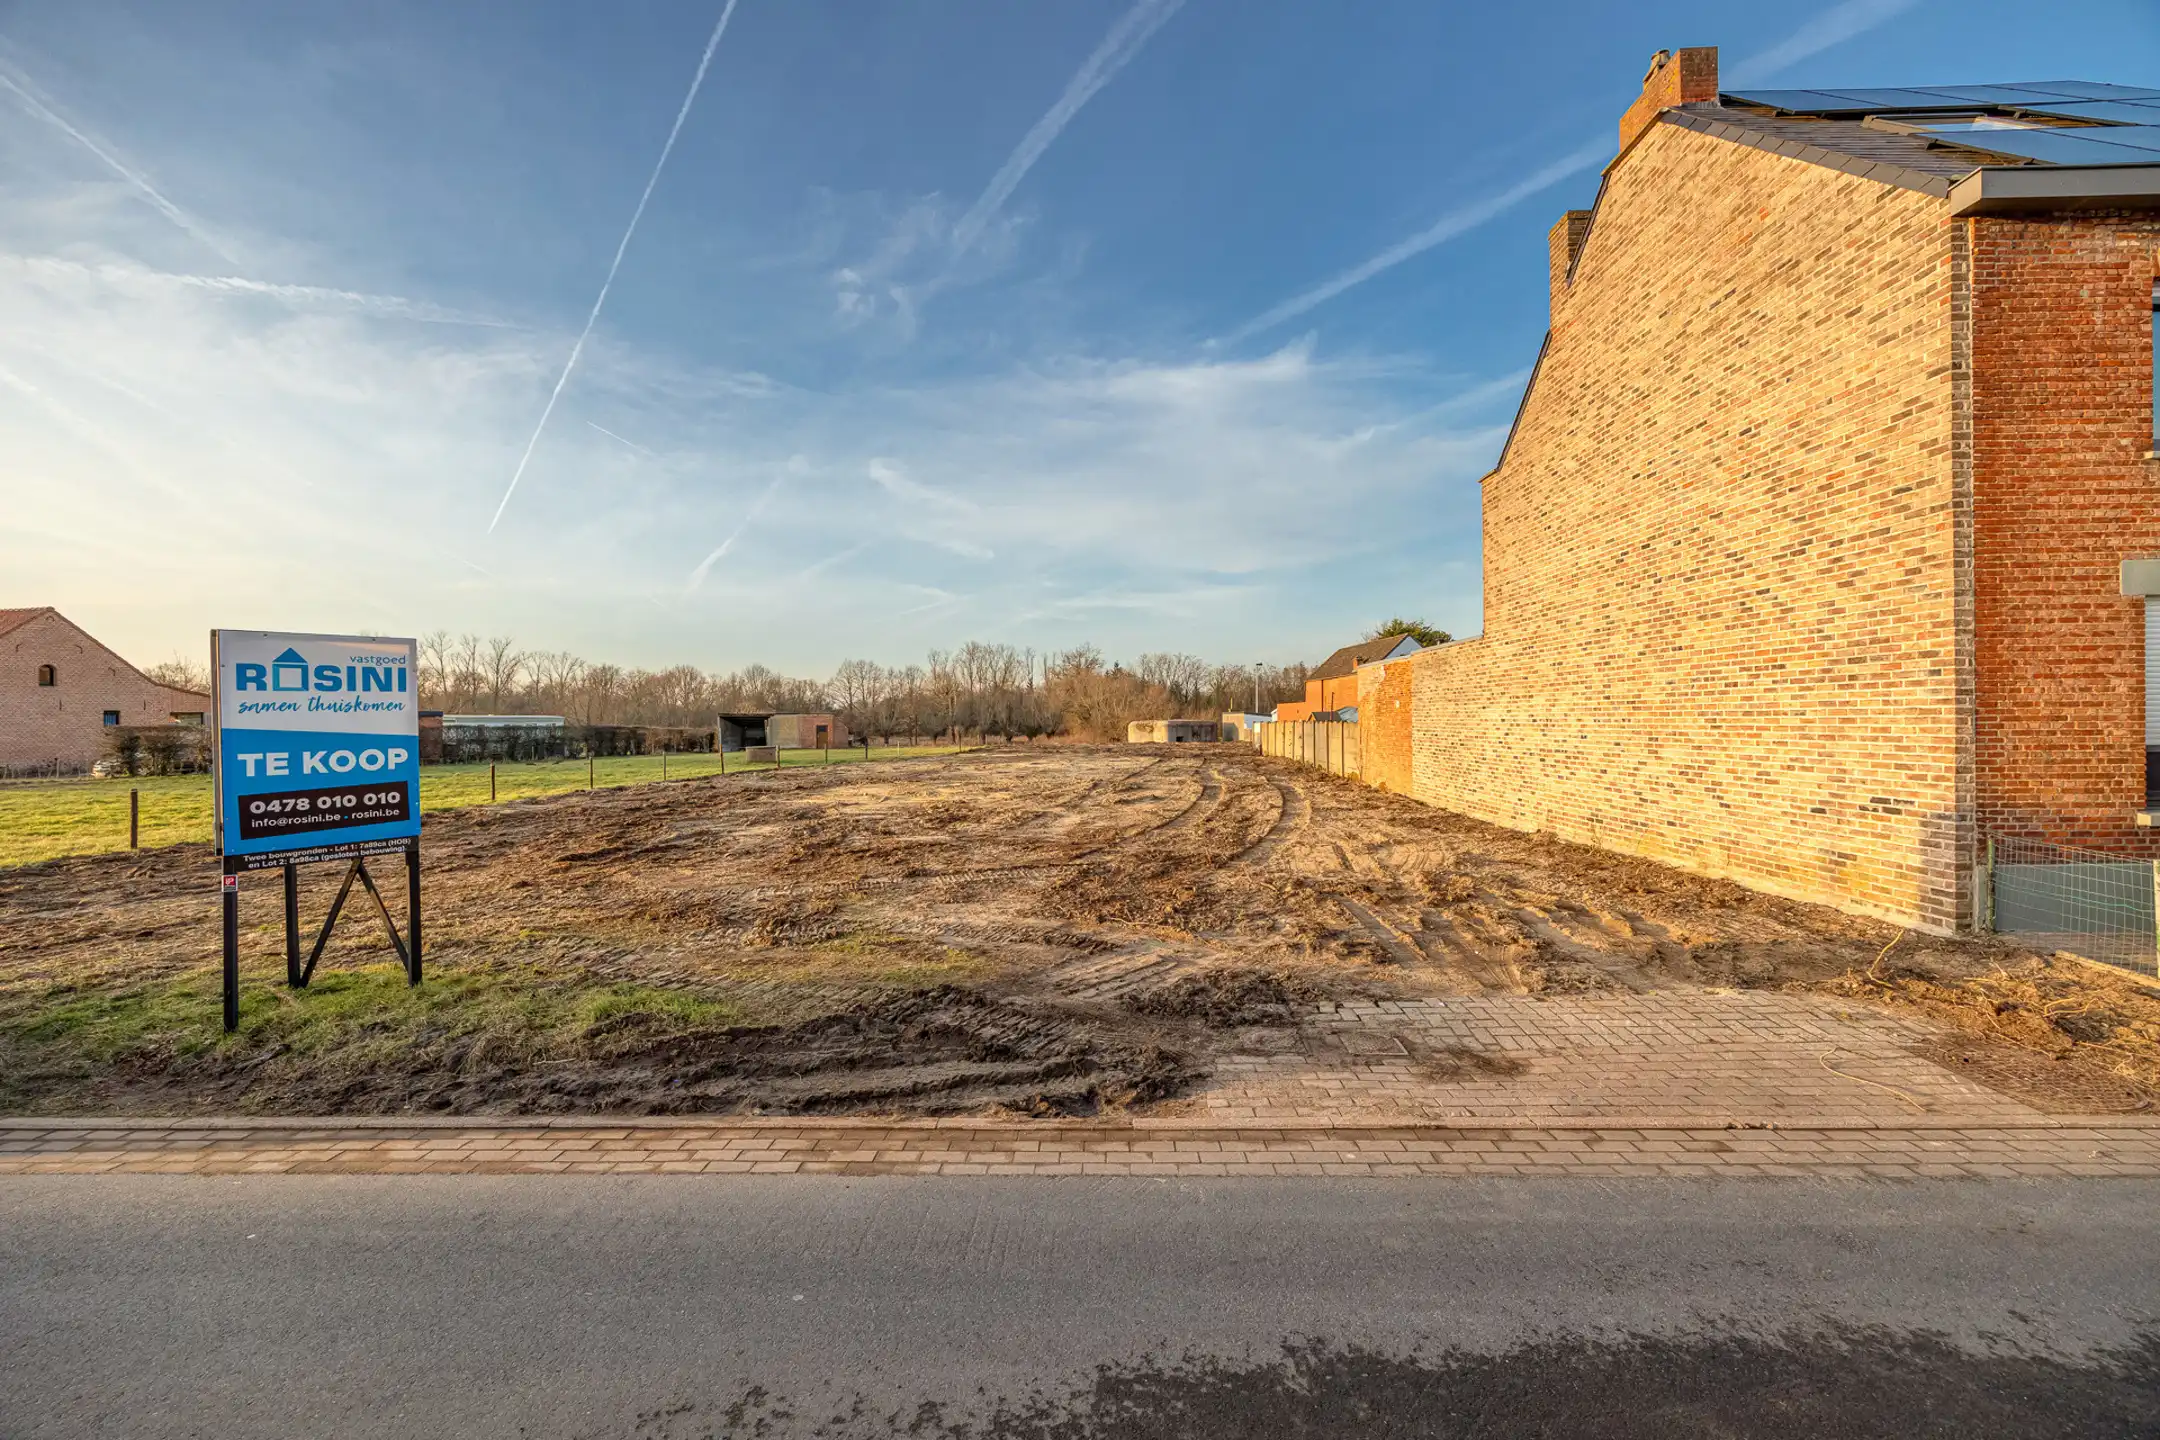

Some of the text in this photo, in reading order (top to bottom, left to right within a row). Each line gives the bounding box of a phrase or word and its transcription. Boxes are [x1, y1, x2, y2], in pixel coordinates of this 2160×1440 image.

[235, 648, 407, 692] ROSINI
[350, 655, 406, 666] vastgoed
[238, 695, 406, 714] samen thuiskomen
[237, 748, 409, 777] TE KOOP
[250, 791, 401, 814] 0478 010 010
[251, 808, 400, 828] info@rosini.be rosini.be
[268, 847, 328, 859] bouwgronden
